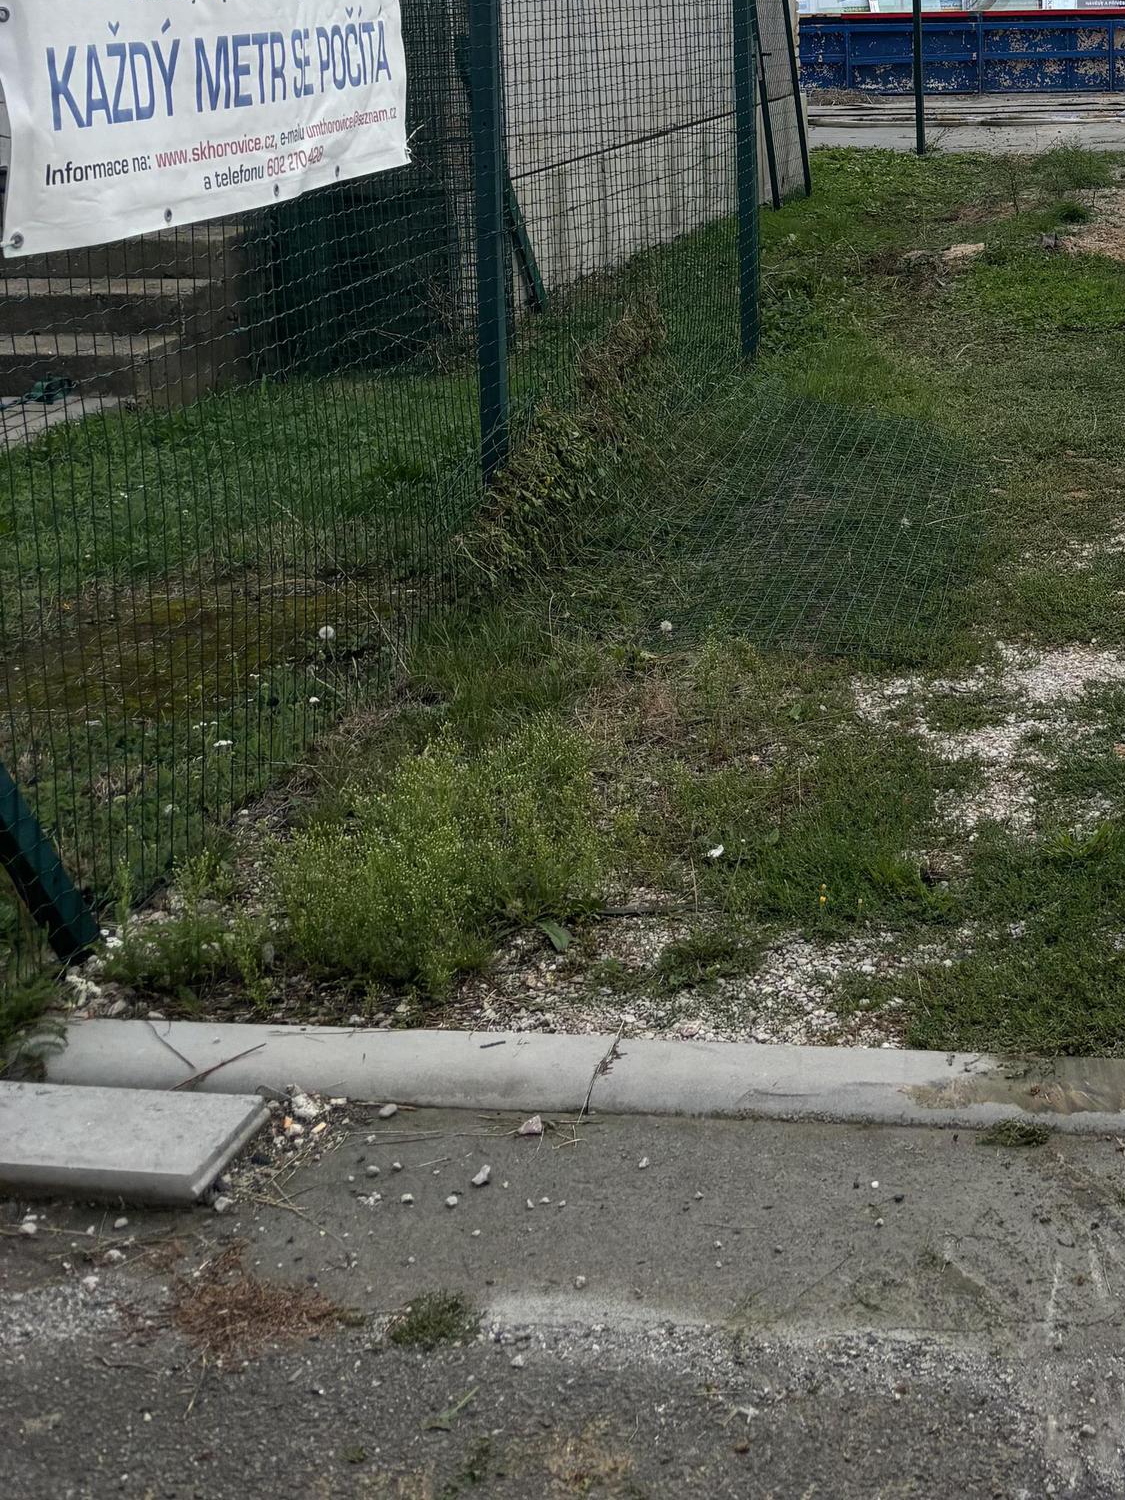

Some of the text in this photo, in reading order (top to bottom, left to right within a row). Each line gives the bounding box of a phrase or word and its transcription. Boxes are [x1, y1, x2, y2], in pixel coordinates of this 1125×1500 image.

[46, 6, 392, 132] KAŽDÝ METR SE POČÍTÁ
[45, 160, 129, 186] Informace
[133, 155, 152, 173] na:
[204, 175, 211, 190] a
[216, 164, 264, 188] telefonu
[267, 155, 286, 177] 602
[288, 150, 307, 171] 270
